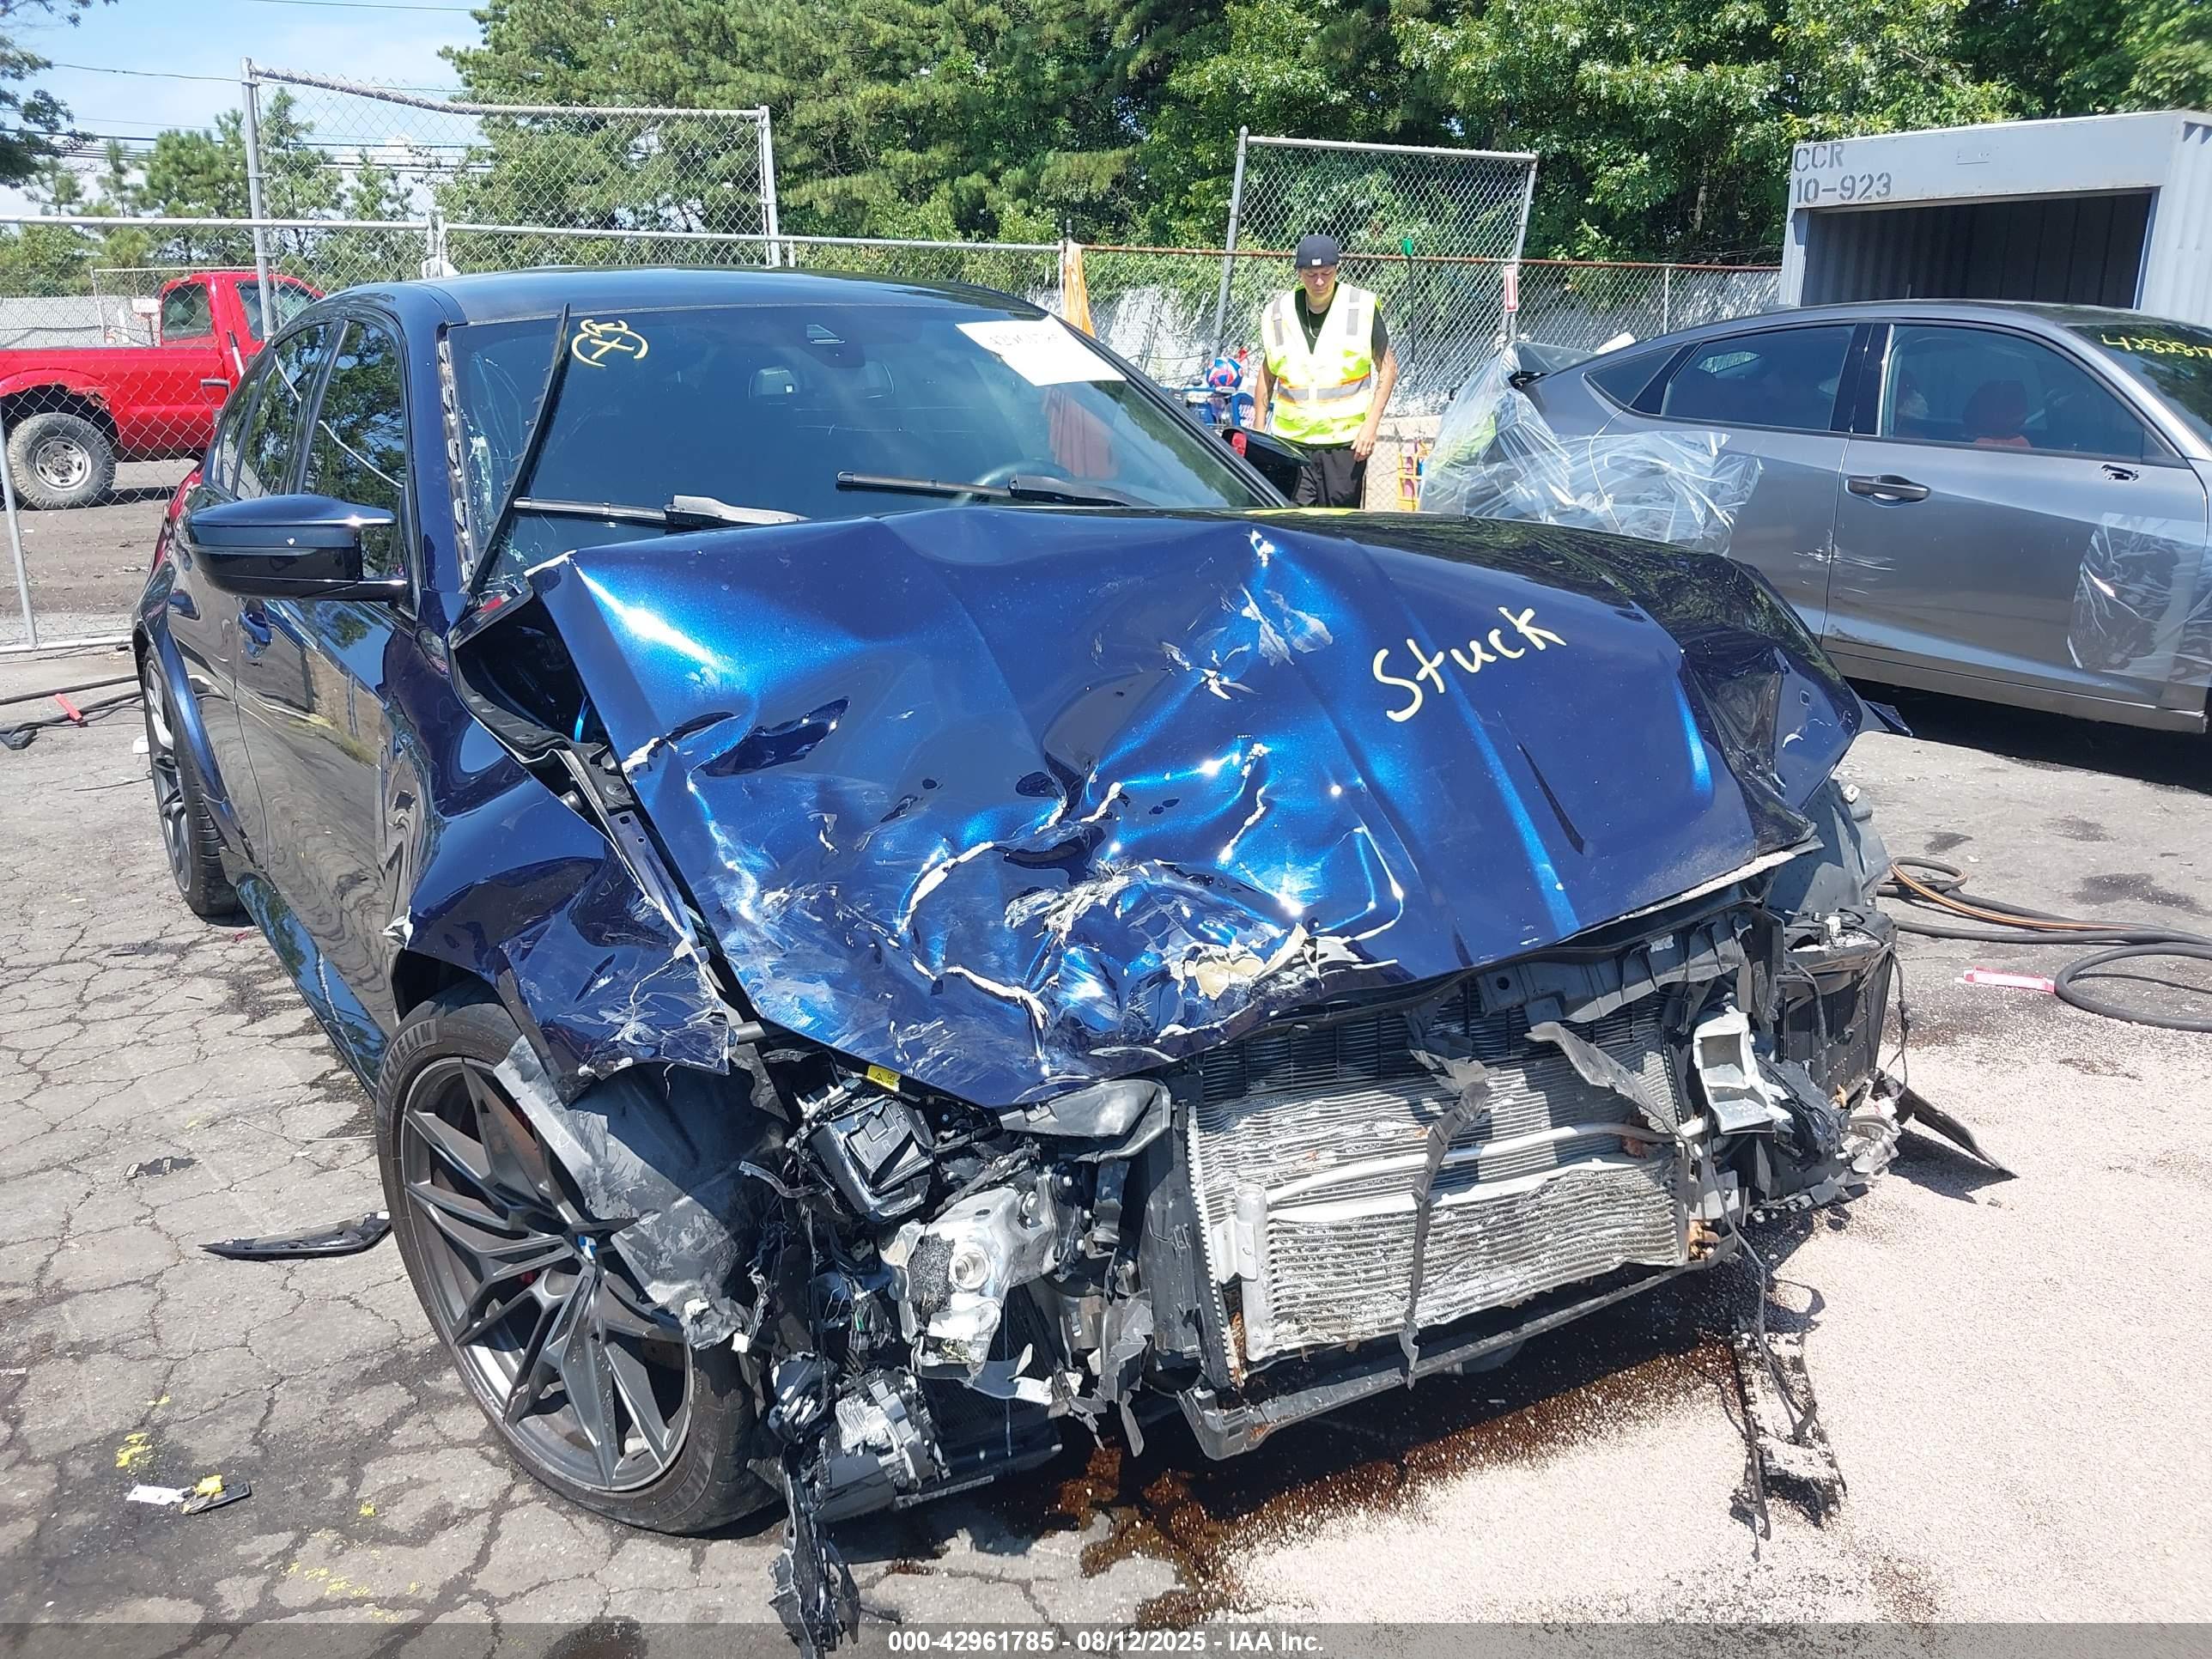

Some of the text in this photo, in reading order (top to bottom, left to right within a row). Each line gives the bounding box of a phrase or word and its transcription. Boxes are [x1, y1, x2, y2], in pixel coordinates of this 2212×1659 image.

[1794, 143, 1844, 173] CCR
[1796, 171, 1893, 204] 10-923
[1372, 606, 1567, 722] Stuck
[378, 1020, 434, 1109] MICHELIN
